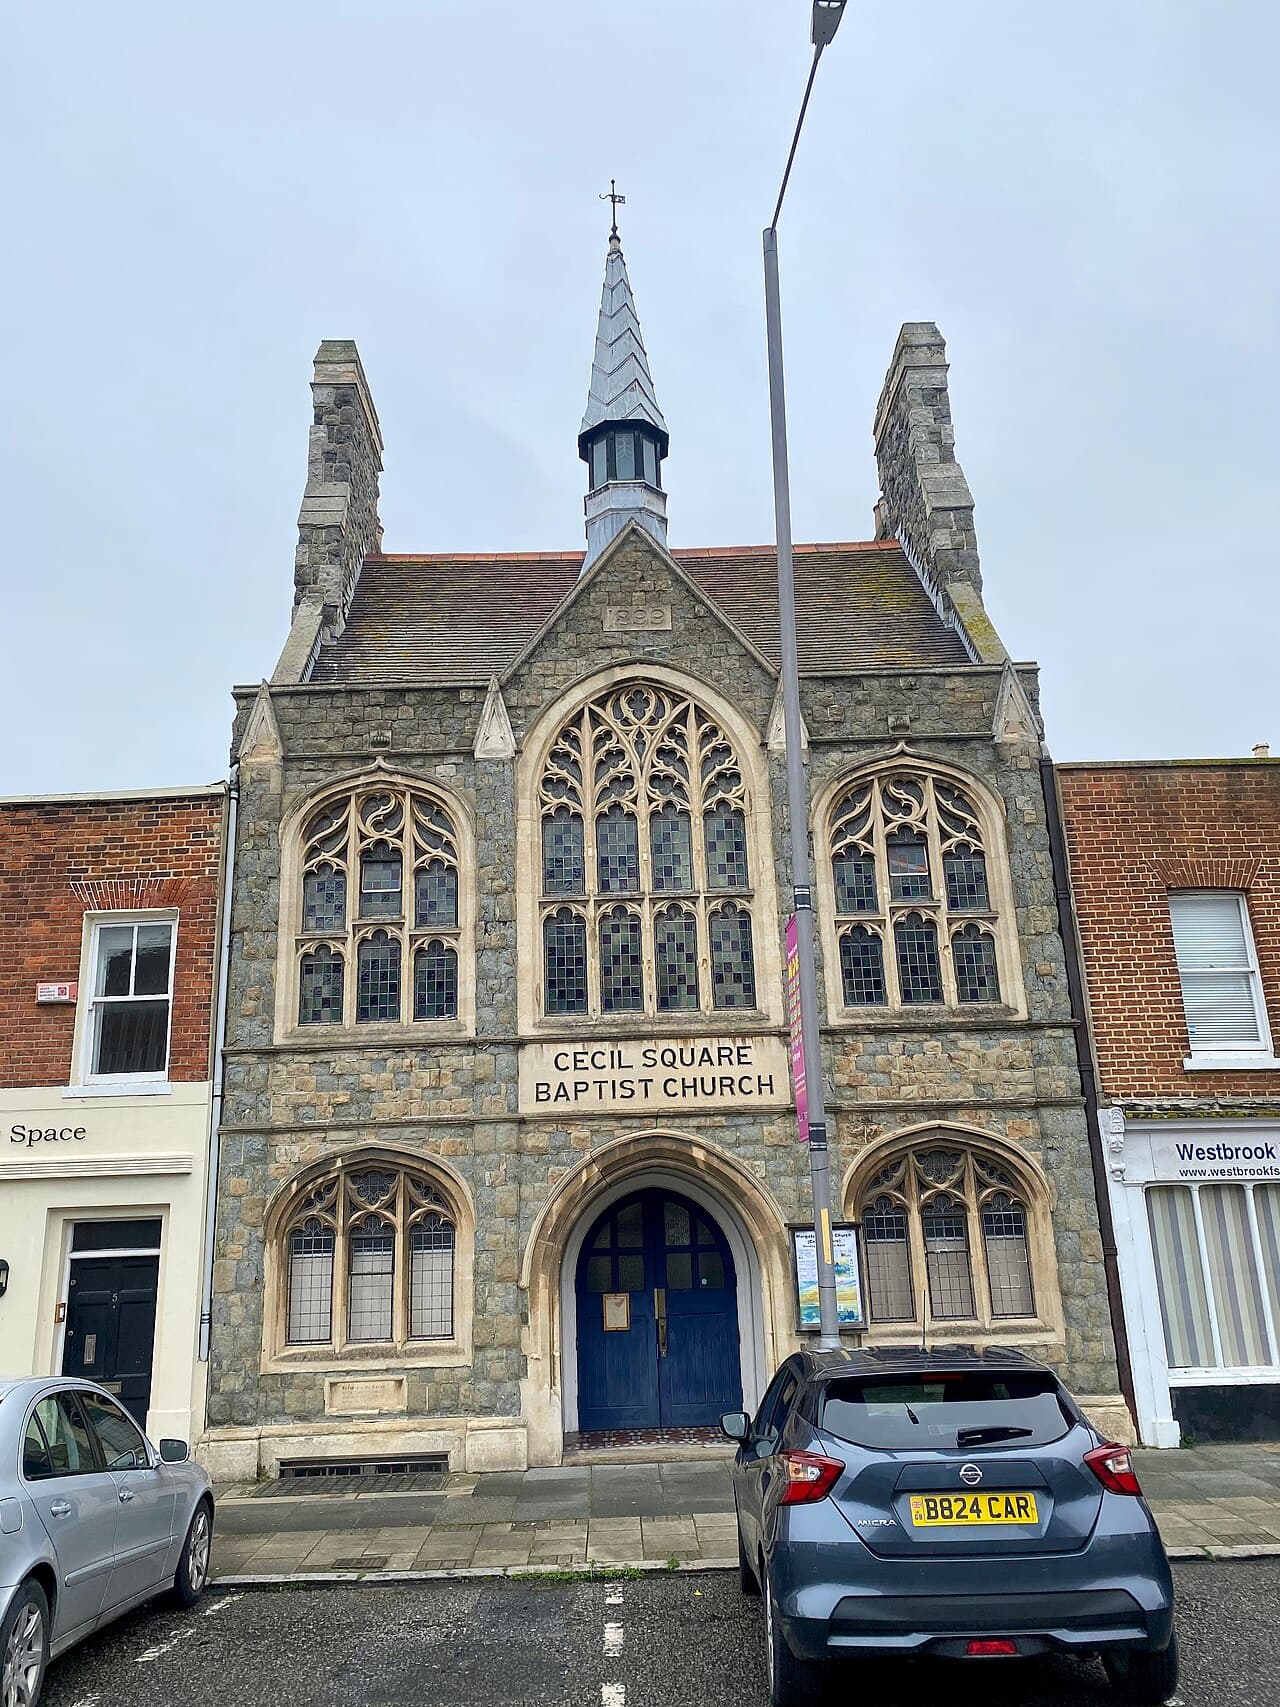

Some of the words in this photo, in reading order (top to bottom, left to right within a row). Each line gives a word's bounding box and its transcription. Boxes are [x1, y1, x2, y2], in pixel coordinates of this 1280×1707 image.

[554, 1050, 633, 1072] CECIL
[642, 1046, 753, 1070] SQUARE
[535, 1078, 654, 1103] BAPTIST
[663, 1074, 775, 1098] CHURCH
[10, 1125, 86, 1147] Space
[1175, 1142, 1277, 1160] Westbrook
[112, 1293, 118, 1302] 5
[924, 1497, 982, 1520] B824
[987, 1496, 1031, 1519] CAR
[857, 1519, 898, 1527] MICRA
